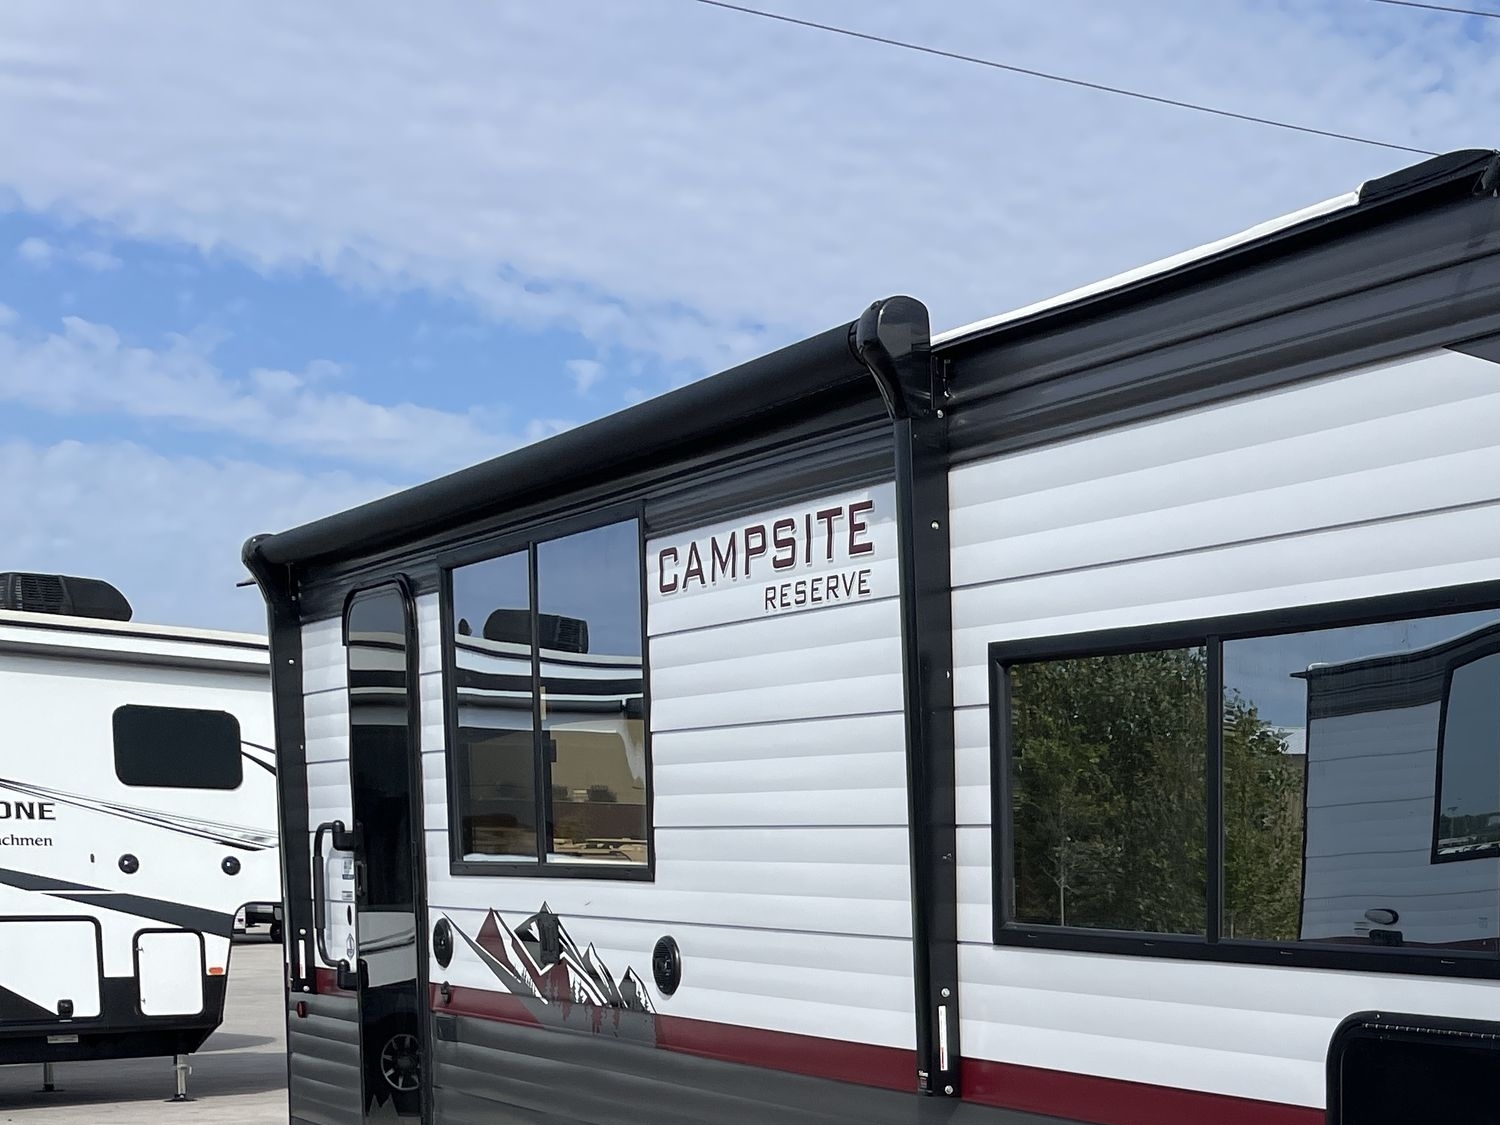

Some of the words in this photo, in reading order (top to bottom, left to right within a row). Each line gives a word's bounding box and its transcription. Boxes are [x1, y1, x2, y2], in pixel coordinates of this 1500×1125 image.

[658, 499, 875, 595] CAMPSITE
[764, 568, 872, 610] RESERVE
[0, 834, 53, 846] chmen
